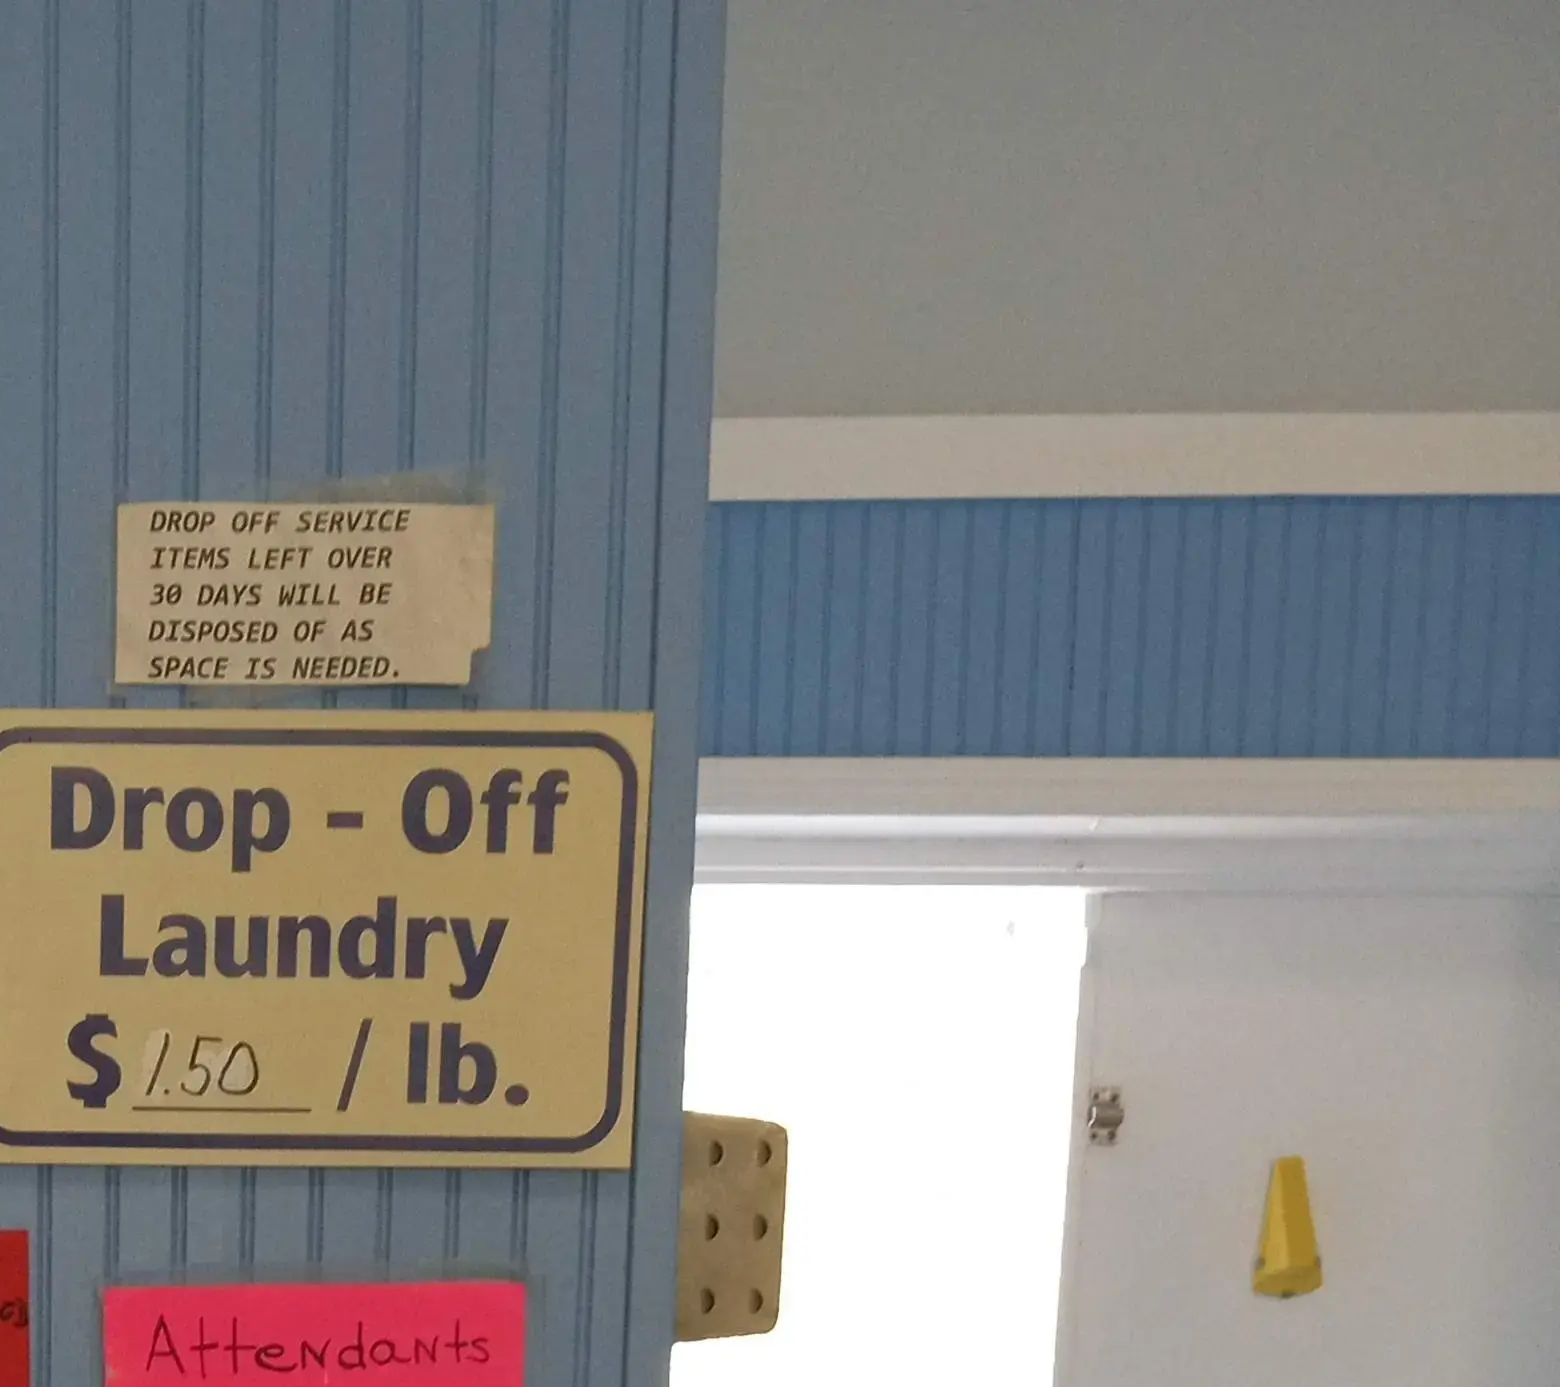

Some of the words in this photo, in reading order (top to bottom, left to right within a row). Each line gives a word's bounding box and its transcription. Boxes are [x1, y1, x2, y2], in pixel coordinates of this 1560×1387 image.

[150, 511, 215, 533] DROP
[231, 511, 279, 533] OFF
[296, 508, 410, 532] SERVICE
[150, 547, 230, 570] ITEMS
[248, 547, 311, 570] LEFT
[328, 546, 392, 569] OVER
[150, 583, 182, 606] 30
[197, 583, 261, 606] DAYS
[279, 583, 340, 606] WILL
[359, 583, 392, 605] BE
[148, 620, 278, 642] DISPOSED
[293, 620, 326, 642] OF
[341, 619, 374, 642] AS
[148, 656, 228, 679] SPACE
[245, 656, 275, 679] IS
[292, 656, 400, 679] NEEDED.
[50, 766, 290, 873] Drop
[401, 767, 570, 854] Off
[99, 894, 509, 1000] Laundry
[146, 1314, 490, 1380] Attendants
